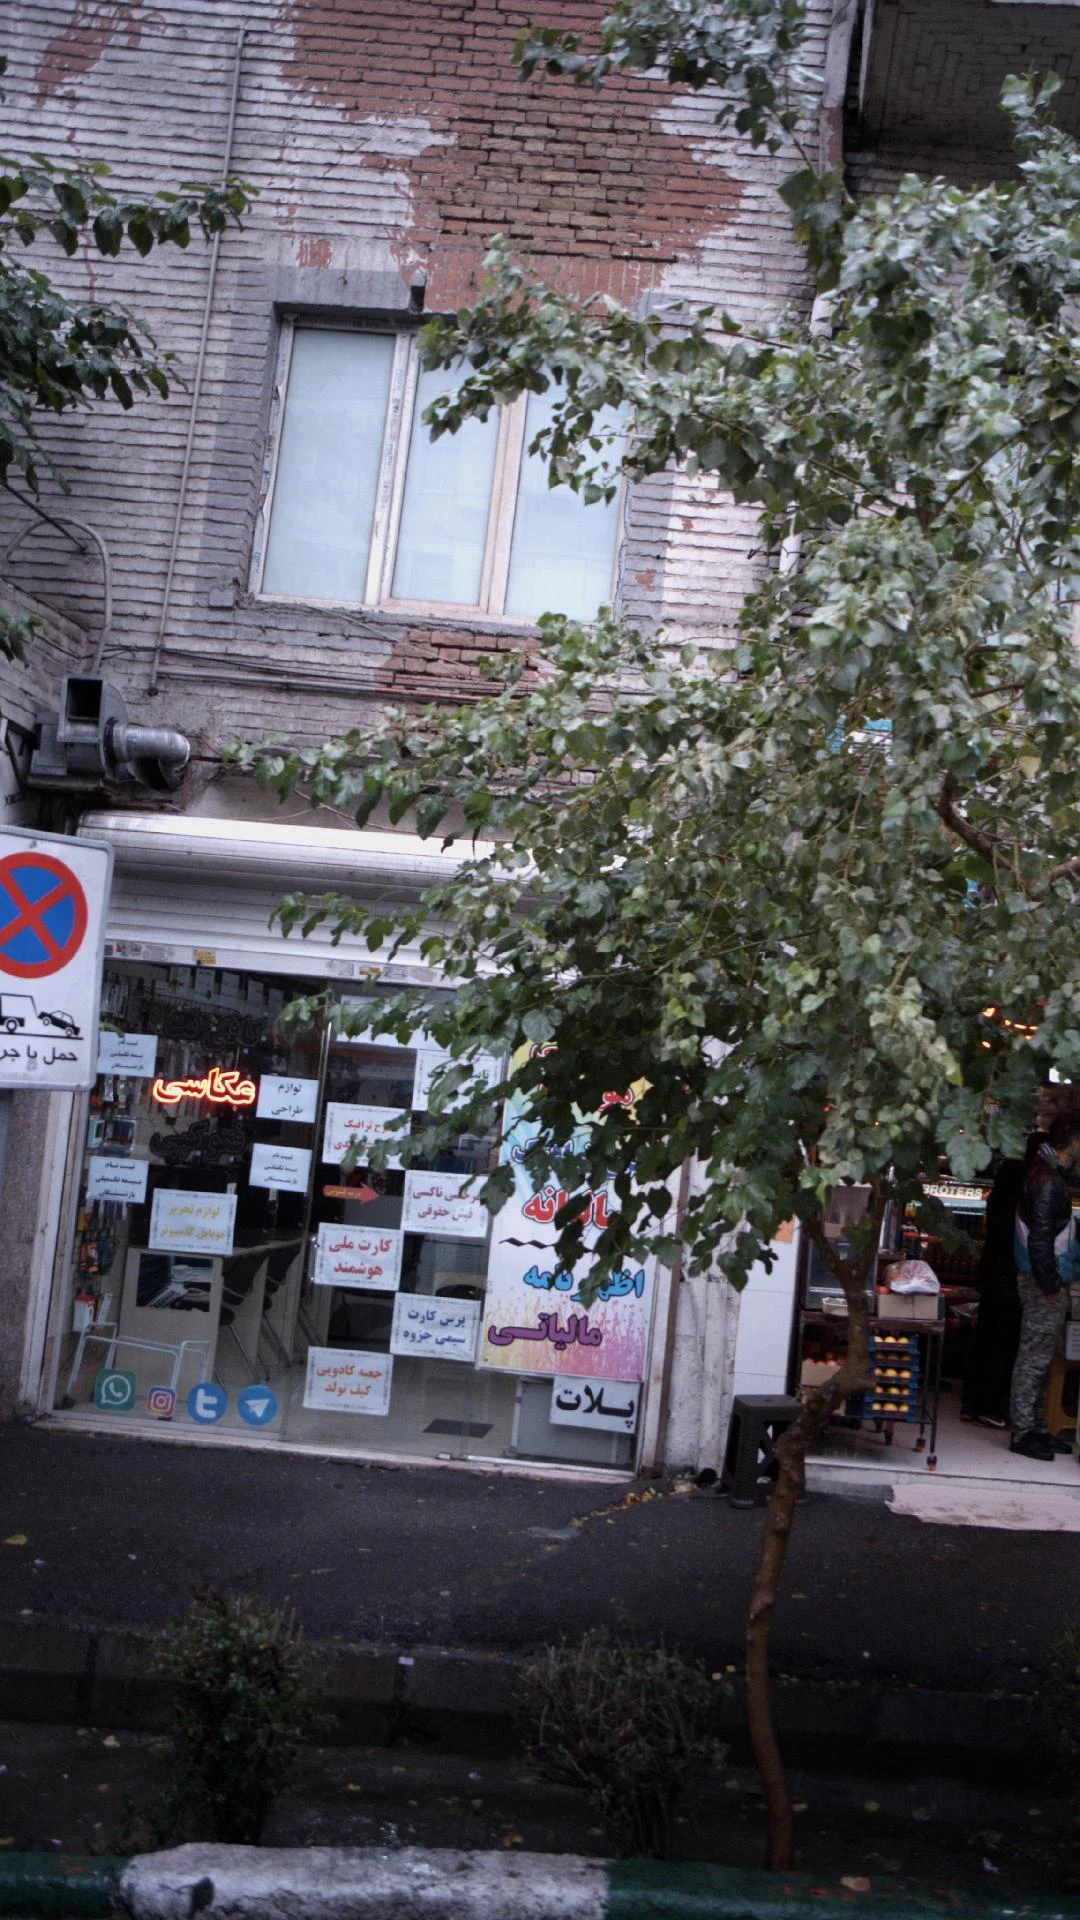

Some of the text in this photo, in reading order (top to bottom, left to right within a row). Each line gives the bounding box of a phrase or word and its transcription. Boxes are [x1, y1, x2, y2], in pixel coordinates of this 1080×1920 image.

[27, 1044, 38, 1060] با
[43, 1047, 78, 1066] حمل
[153, 1067, 256, 1105] عکاسی
[277, 1083, 302, 1096] لوازم
[271, 1105, 303, 1117] طراحی
[344, 1120, 373, 1133] ترافیک
[413, 1186, 443, 1200] تاکسی
[418, 1203, 473, 1222] فیش حقوقی
[329, 1235, 393, 1256] کارت ملی
[333, 1259, 384, 1280] هوشمند
[407, 1309, 437, 1324] کارت
[403, 1329, 466, 1345] سیمی جزوه
[488, 1312, 603, 1351] مالیاتی
[316, 1364, 383, 1380] جعبه کادویی
[324, 1382, 372, 1399] کیف تولد
[556, 1384, 635, 1429] پلات
